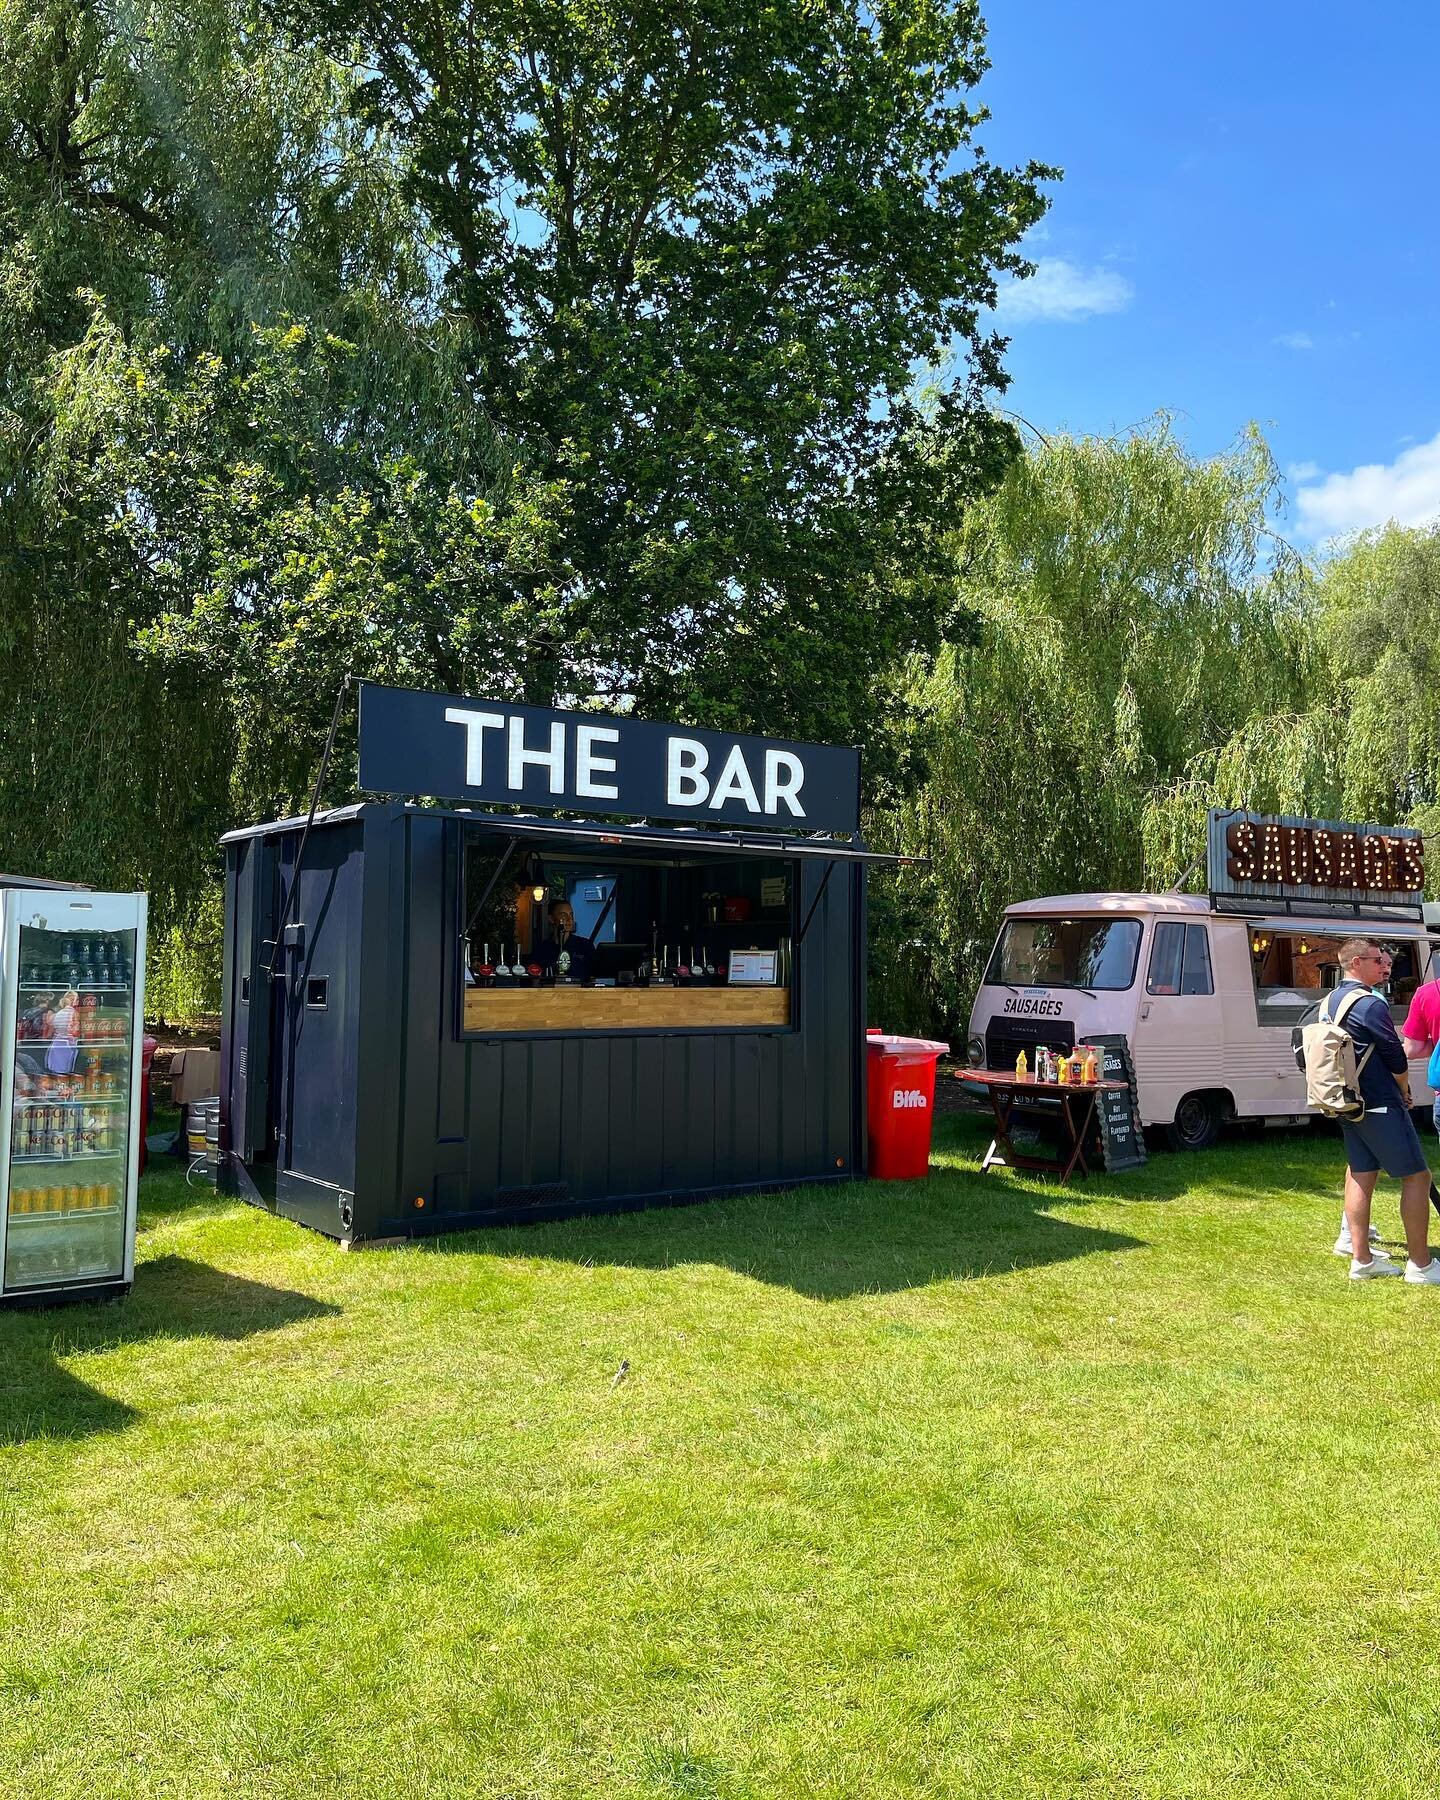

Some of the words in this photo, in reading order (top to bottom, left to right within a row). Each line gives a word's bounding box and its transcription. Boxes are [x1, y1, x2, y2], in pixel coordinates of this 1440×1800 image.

[445, 708, 619, 799] THE
[667, 737, 806, 817] BAR
[1227, 821, 1424, 892] SAUSAGES
[1003, 998, 1063, 1016] SAUSAGES
[893, 1090, 927, 1108] Biffa
